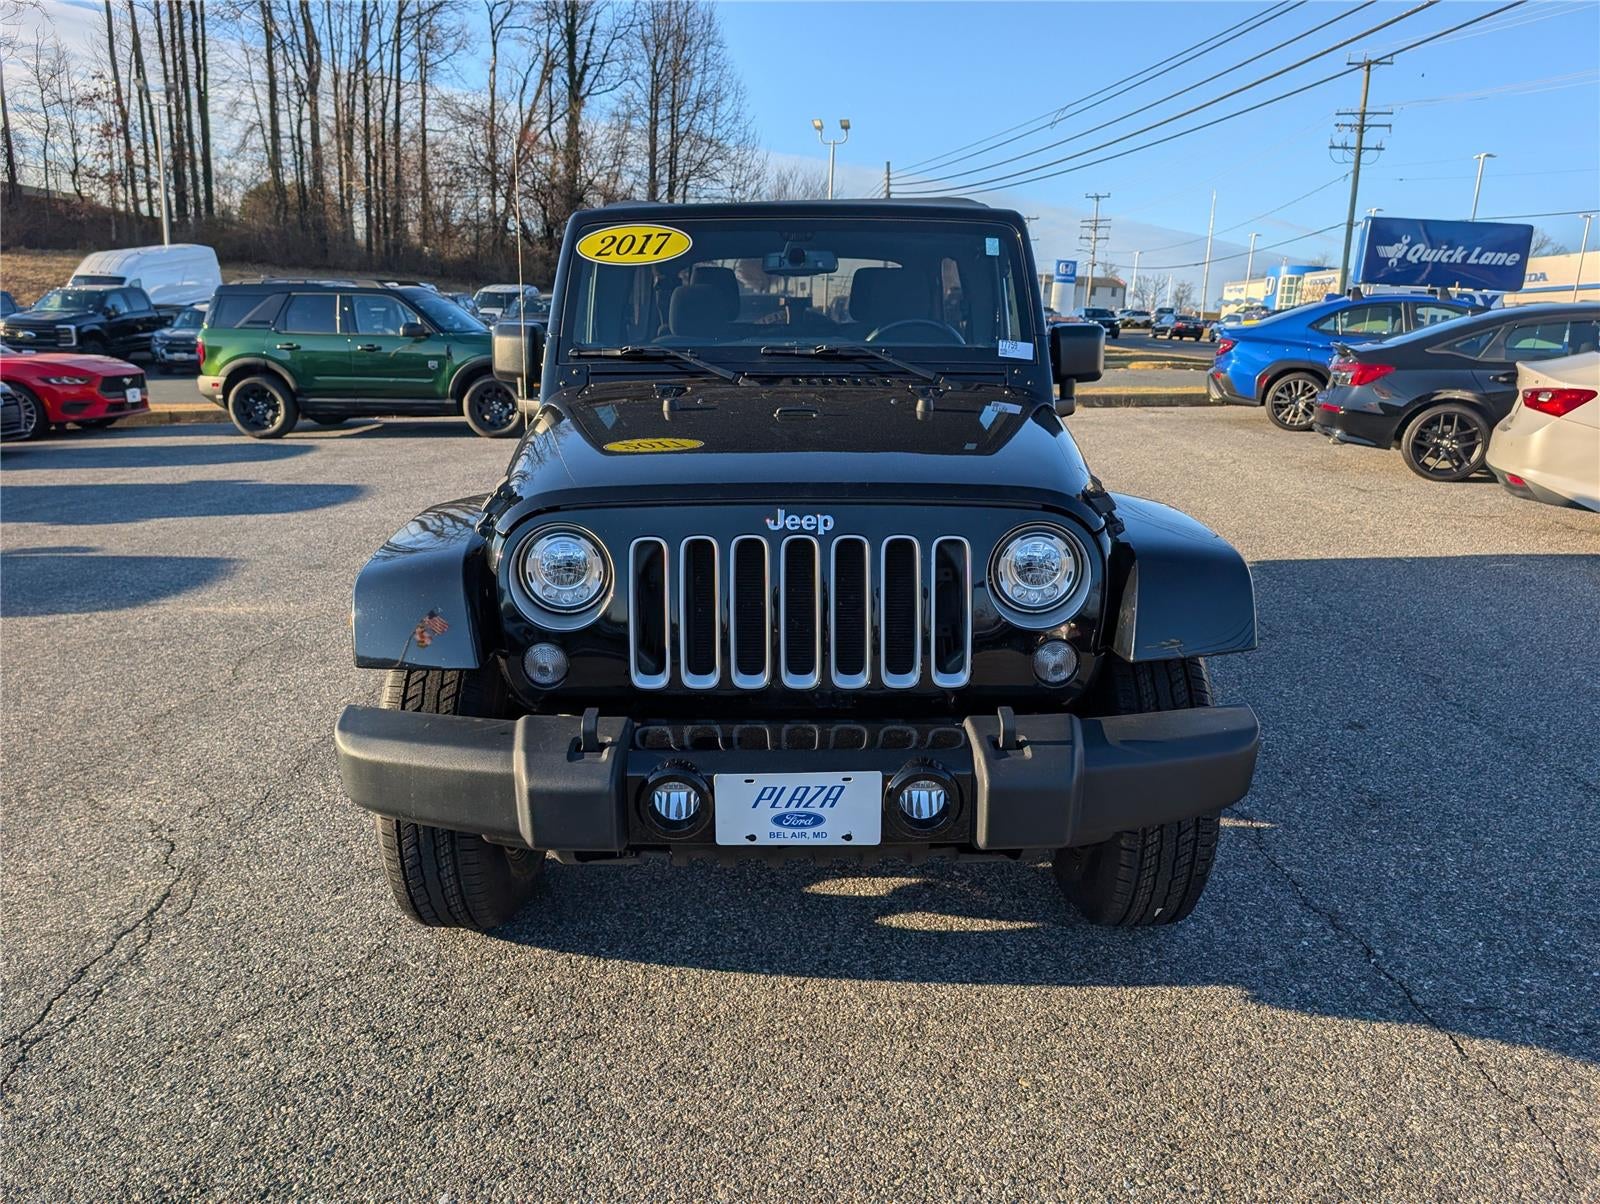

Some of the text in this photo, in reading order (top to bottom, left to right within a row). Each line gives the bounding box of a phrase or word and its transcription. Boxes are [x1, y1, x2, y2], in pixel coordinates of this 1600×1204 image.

[595, 233, 672, 256] 2017
[1406, 243, 1520, 266] Quick Lane
[765, 508, 834, 535] Jeep
[752, 785, 846, 809] PLAZA
[782, 812, 815, 827] Ford
[768, 831, 828, 841] BEL AIR, MD
